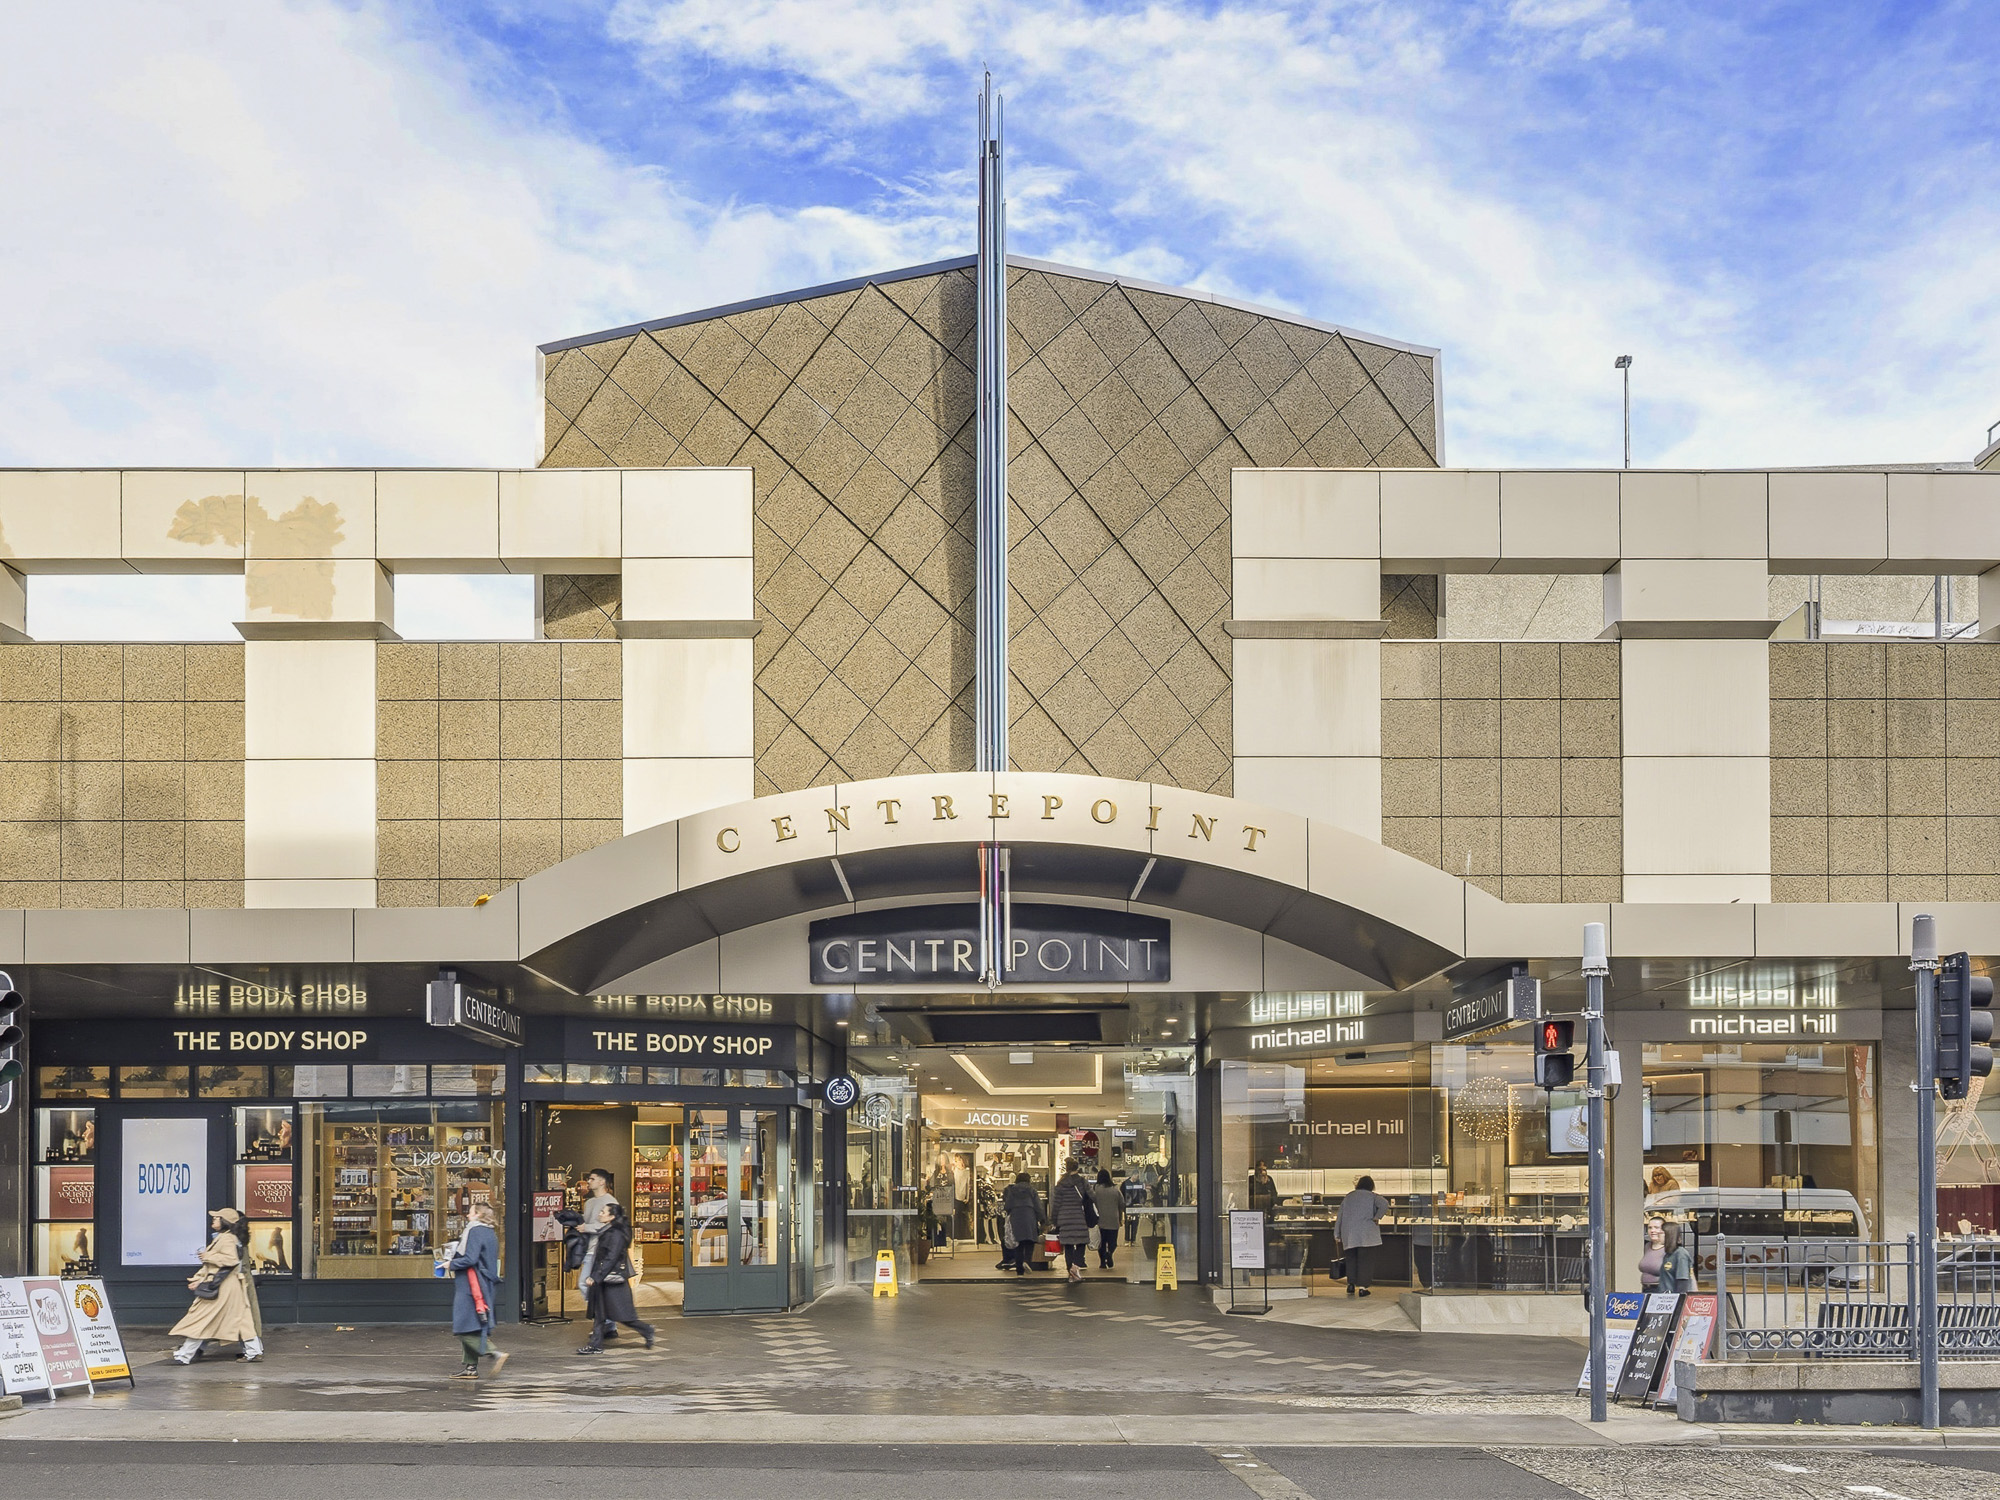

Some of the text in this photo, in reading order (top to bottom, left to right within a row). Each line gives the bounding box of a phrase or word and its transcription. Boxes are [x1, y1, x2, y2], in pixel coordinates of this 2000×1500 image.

[716, 792, 1269, 855] CENTREPOINT
[821, 937, 1159, 974] CENTRPOINT
[465, 995, 521, 1035] CENTREPOINT
[1446, 991, 1503, 1031] CENTREPOINT
[1690, 1013, 1838, 1034] michael hill
[173, 1031, 368, 1052] THE BODY SHOP
[592, 1031, 773, 1056] THE BODY SHOP
[1252, 1020, 1365, 1050] michael hill
[1288, 1118, 1404, 1136] michael hill
[1082, 1140, 1100, 1149] SALE
[471, 1193, 490, 1205] FREE
[535, 1195, 562, 1207] 20% OFF
[14, 1362, 34, 1375] OPEN
[48, 1361, 66, 1371] OPEN
